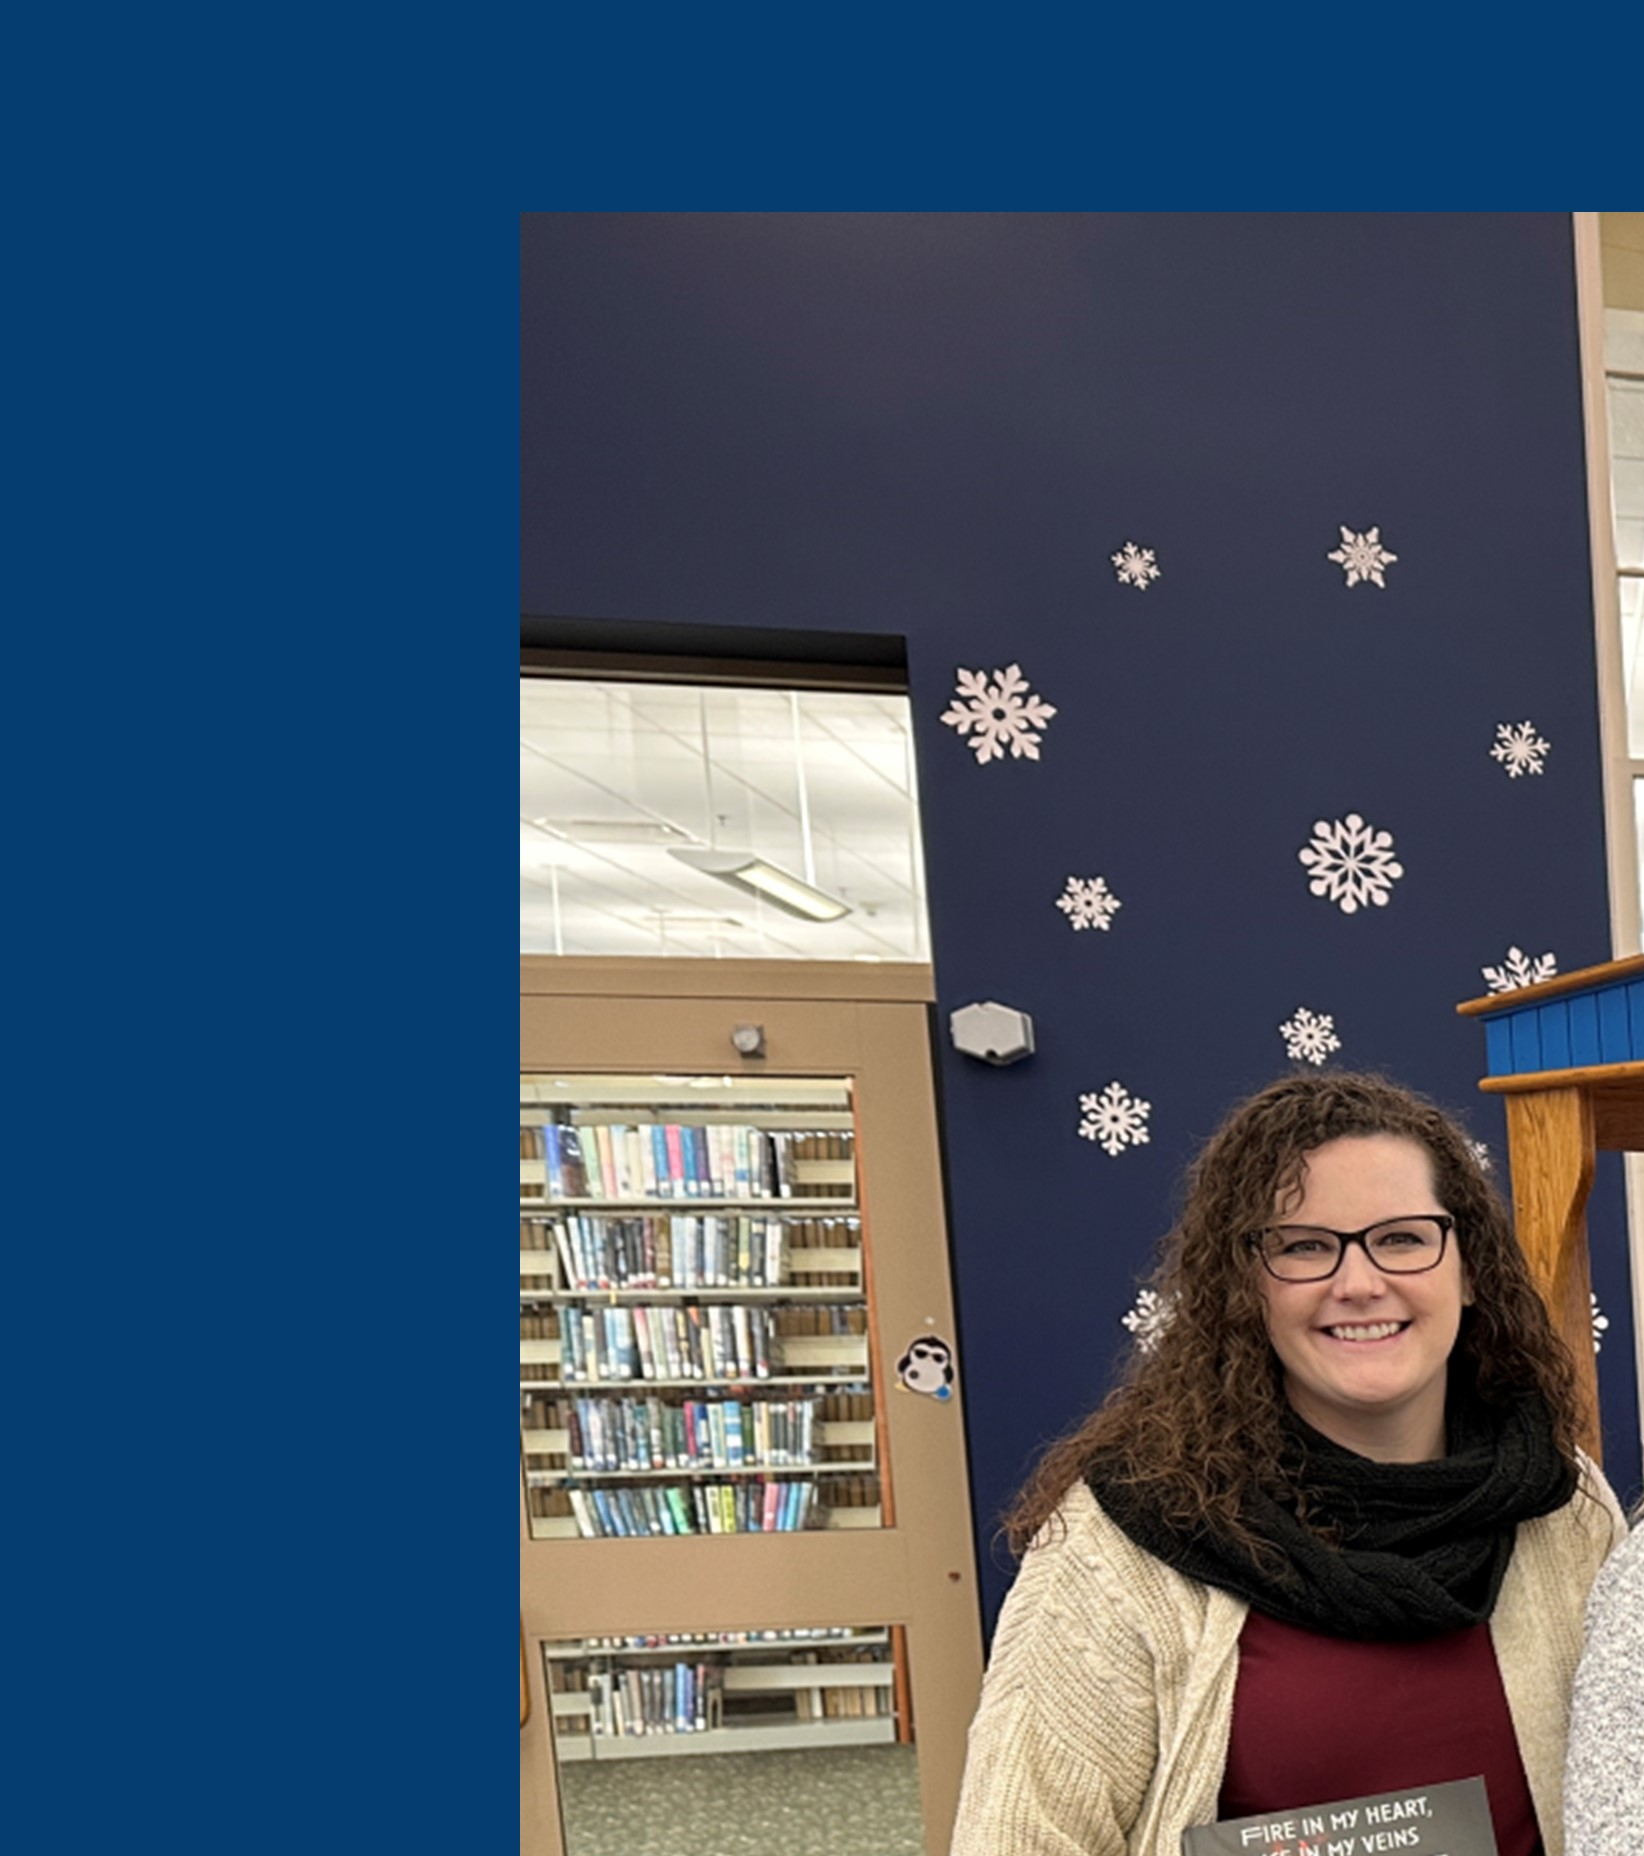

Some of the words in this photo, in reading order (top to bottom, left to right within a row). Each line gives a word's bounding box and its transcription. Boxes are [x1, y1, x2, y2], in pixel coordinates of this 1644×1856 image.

[1240, 1822, 1296, 1846] FIRE
[1303, 1818, 1324, 1835] IN
[1330, 1809, 1360, 1829] MY
[1365, 1797, 1433, 1824] HEART,
[1362, 1826, 1420, 1854] VEINS
